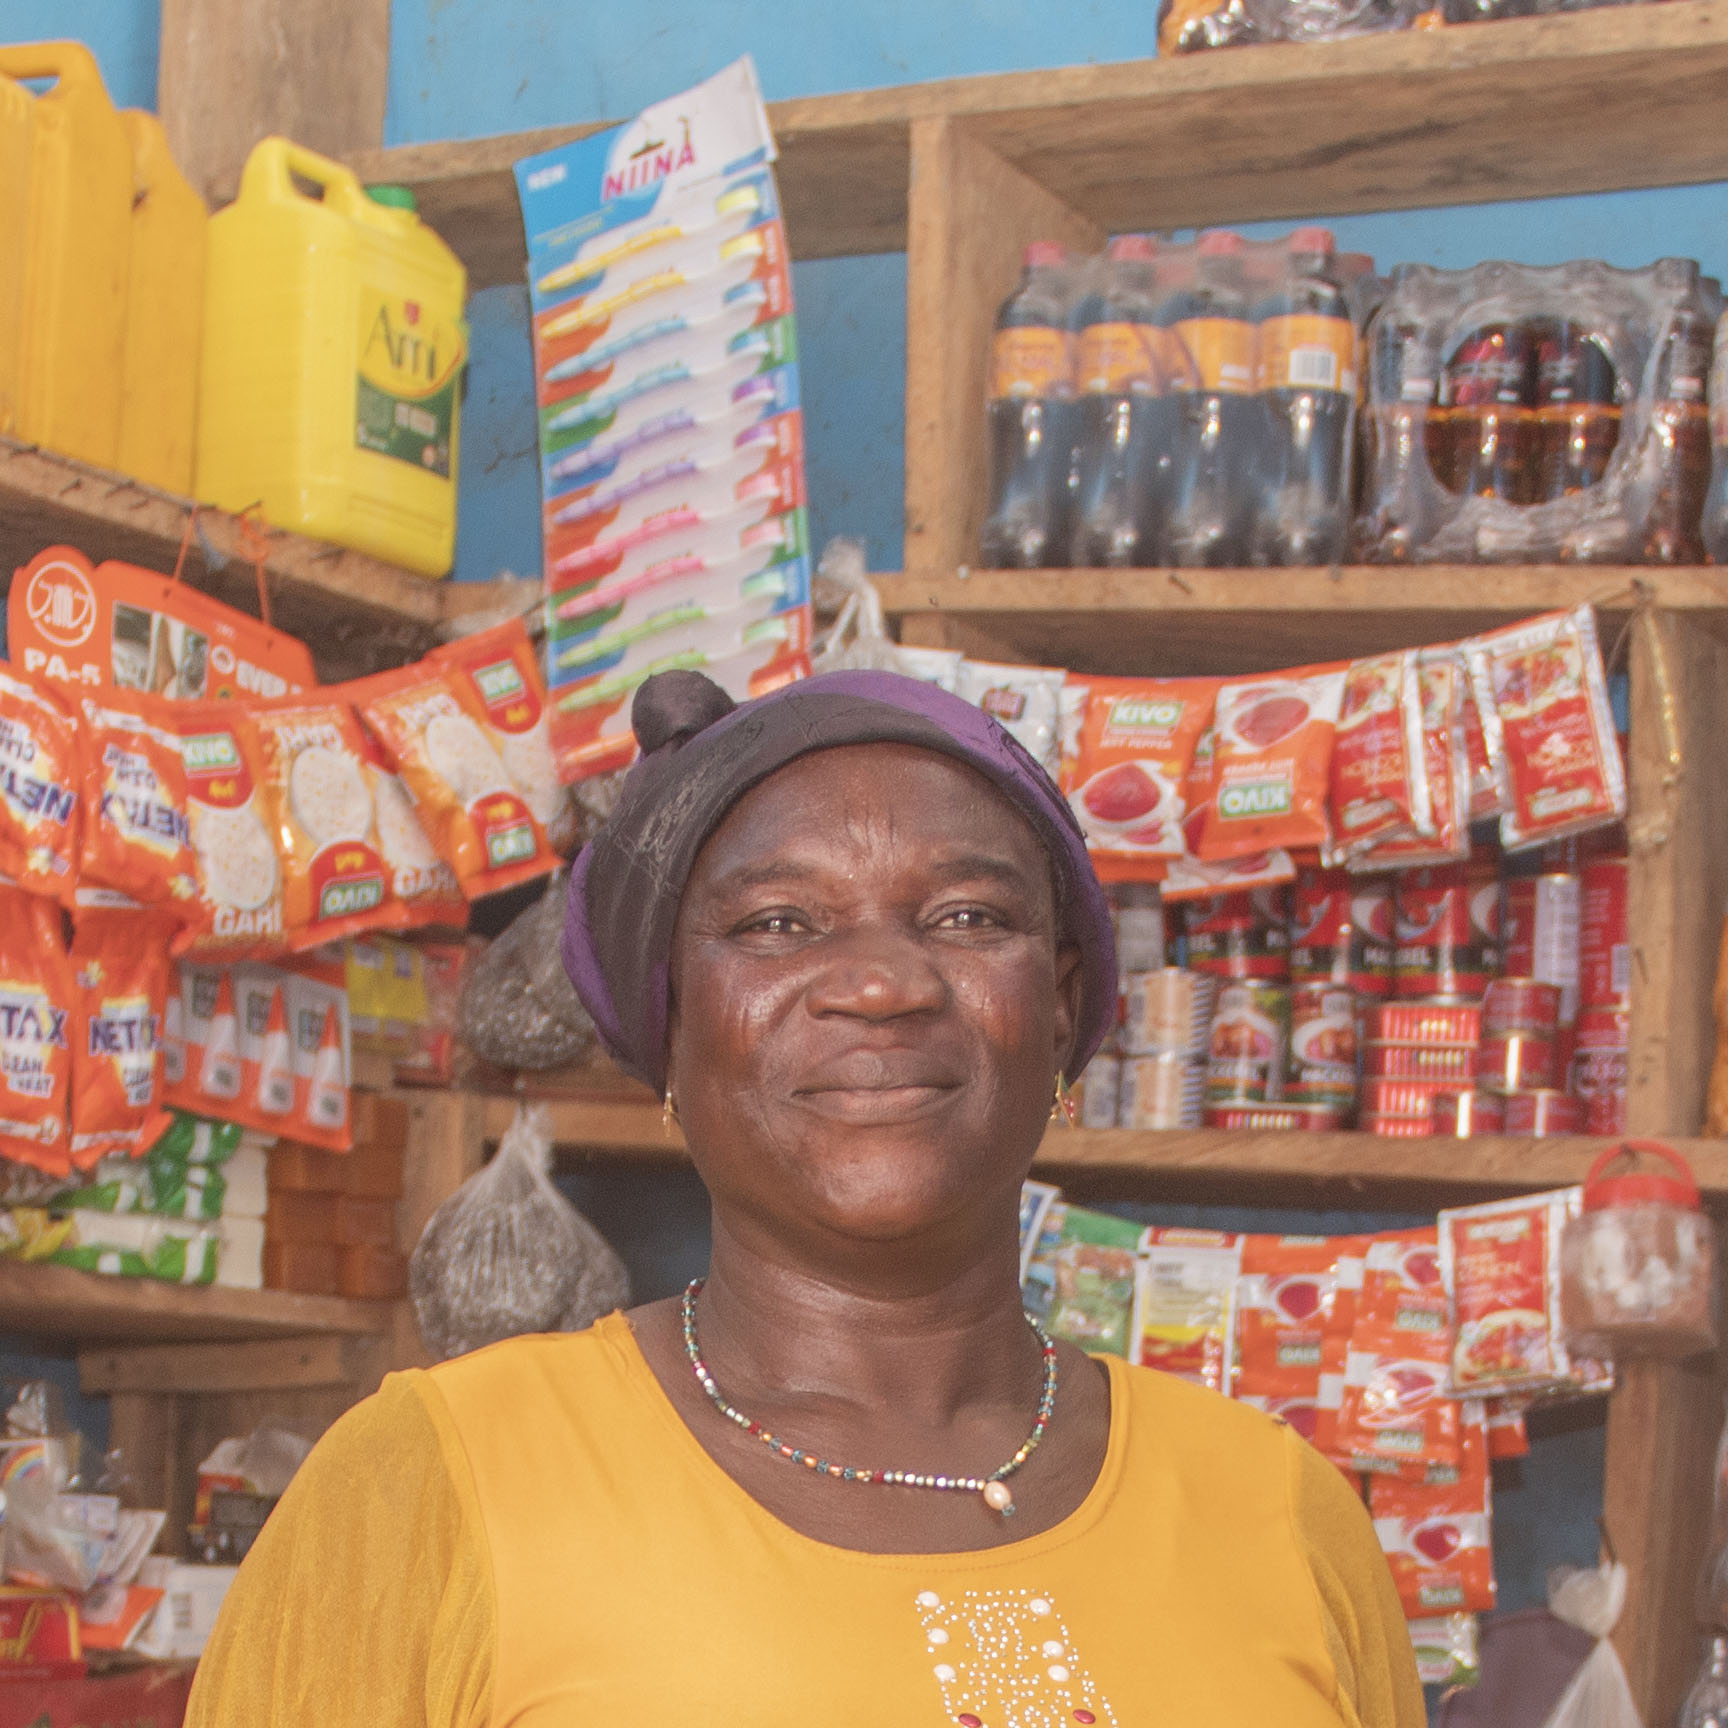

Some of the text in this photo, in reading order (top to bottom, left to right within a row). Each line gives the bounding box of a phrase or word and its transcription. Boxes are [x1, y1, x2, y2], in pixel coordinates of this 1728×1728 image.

[604, 143, 696, 201] NIINA
[1113, 704, 1178, 725] KIVO
[1223, 786, 1289, 814] KIVO
